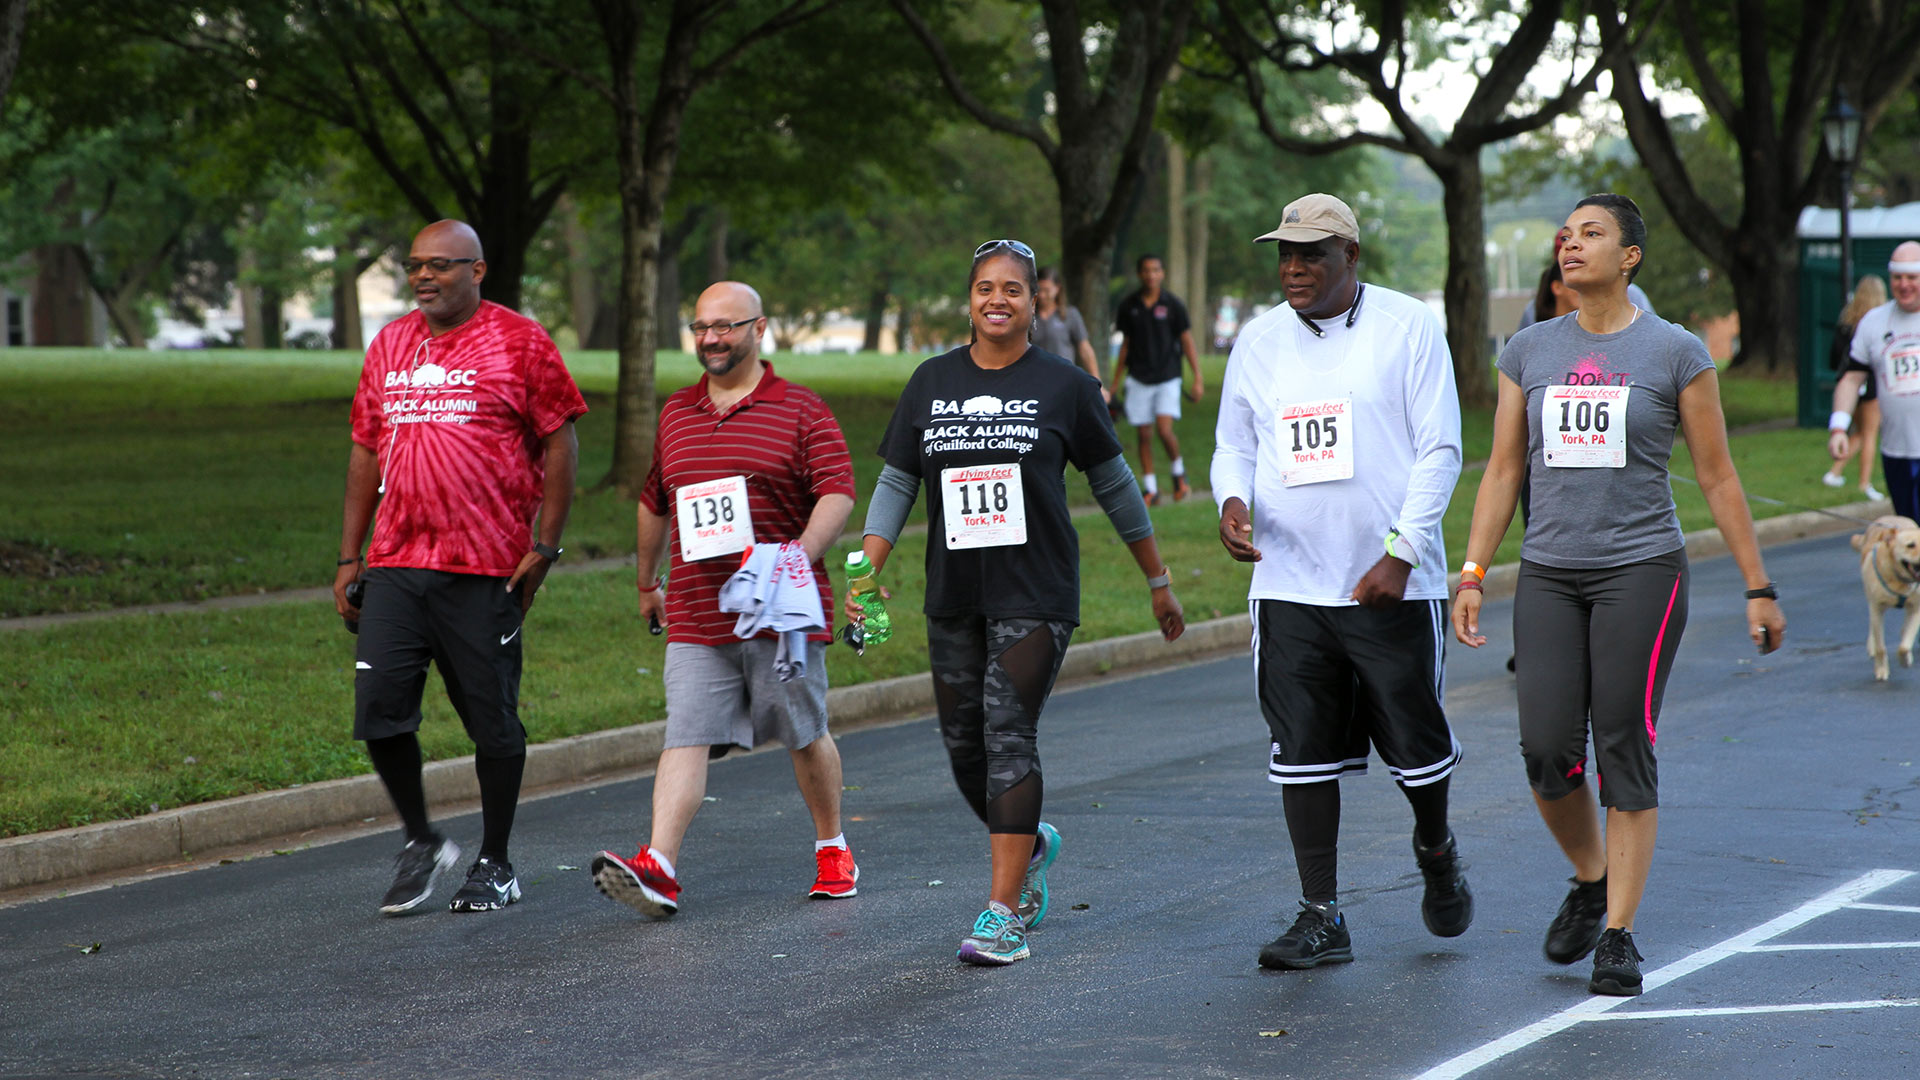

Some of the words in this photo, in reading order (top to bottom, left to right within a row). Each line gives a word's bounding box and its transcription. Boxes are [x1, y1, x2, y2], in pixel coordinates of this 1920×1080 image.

[446, 369, 478, 386] GC
[1564, 372, 1631, 386] DON'T
[420, 399, 477, 412] ALUMNI
[931, 399, 960, 415] BA
[1004, 399, 1039, 414] GC
[391, 412, 431, 424] Guilford
[432, 412, 472, 425] College
[1559, 401, 1609, 432] 106
[923, 425, 970, 441] BLACK
[972, 424, 1039, 440] ALUMNI
[1291, 416, 1338, 452] 105
[1561, 434, 1588, 446] York,
[1591, 434, 1606, 445] PA
[925, 441, 934, 456] of
[933, 438, 985, 452] Guilford
[987, 437, 1033, 454] College
[1294, 452, 1319, 463] York,
[1321, 449, 1335, 460] PA
[959, 482, 1008, 515] 118
[692, 496, 734, 528] 138
[964, 516, 990, 527] York,
[992, 514, 1007, 524] PA
